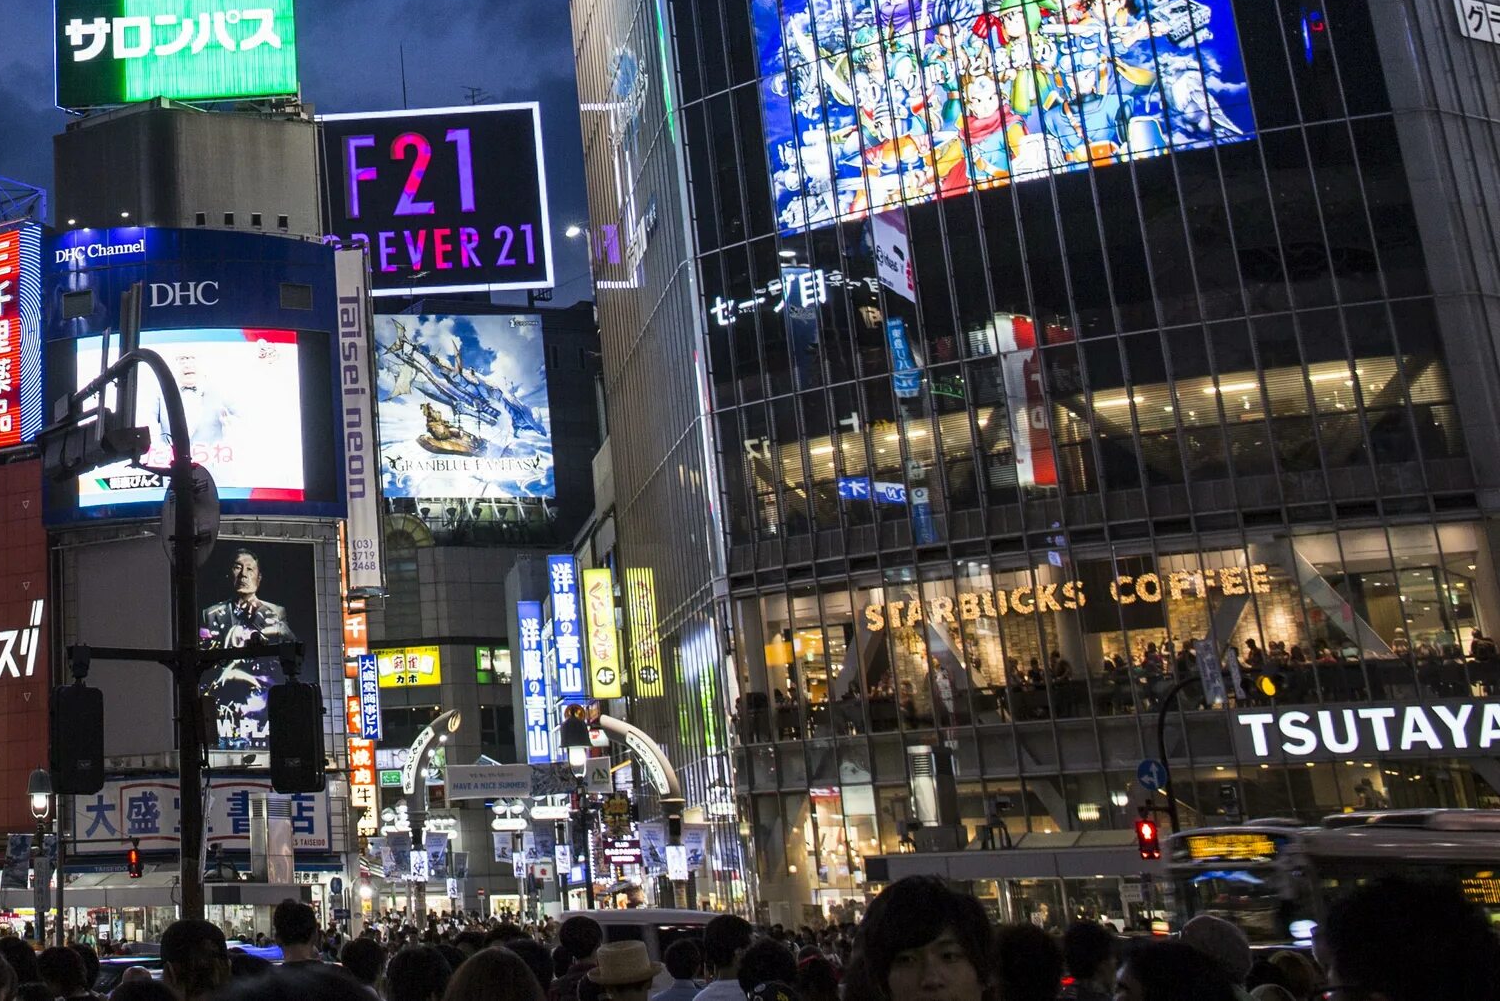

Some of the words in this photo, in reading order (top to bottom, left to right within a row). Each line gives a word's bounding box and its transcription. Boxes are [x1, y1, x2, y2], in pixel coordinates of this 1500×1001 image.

[64, 8, 283, 62] サロンパス
[55, 246, 85, 264] DHC
[87, 238, 145, 259] Channel
[493, 223, 536, 266] 21
[149, 281, 220, 307] DHC
[338, 286, 366, 401] Taisei
[345, 407, 367, 499] neon
[351, 551, 376, 561] 3719
[352, 539, 374, 550] (03)
[351, 561, 376, 572] 2468
[865, 580, 1086, 631] STARBUCKS
[1110, 563, 1271, 604] COFFEE
[550, 562, 582, 693] 洋服の青山
[361, 657, 378, 736] 大盛堂商事ビル
[520, 618, 549, 759] 洋服の青山
[597, 668, 614, 682] 4F
[452, 781, 471, 790] HAVE
[473, 781, 479, 789] A
[480, 781, 497, 789] NICE
[85, 790, 315, 839] 大盛書店
[300, 838, 326, 847] TAISEIDO
